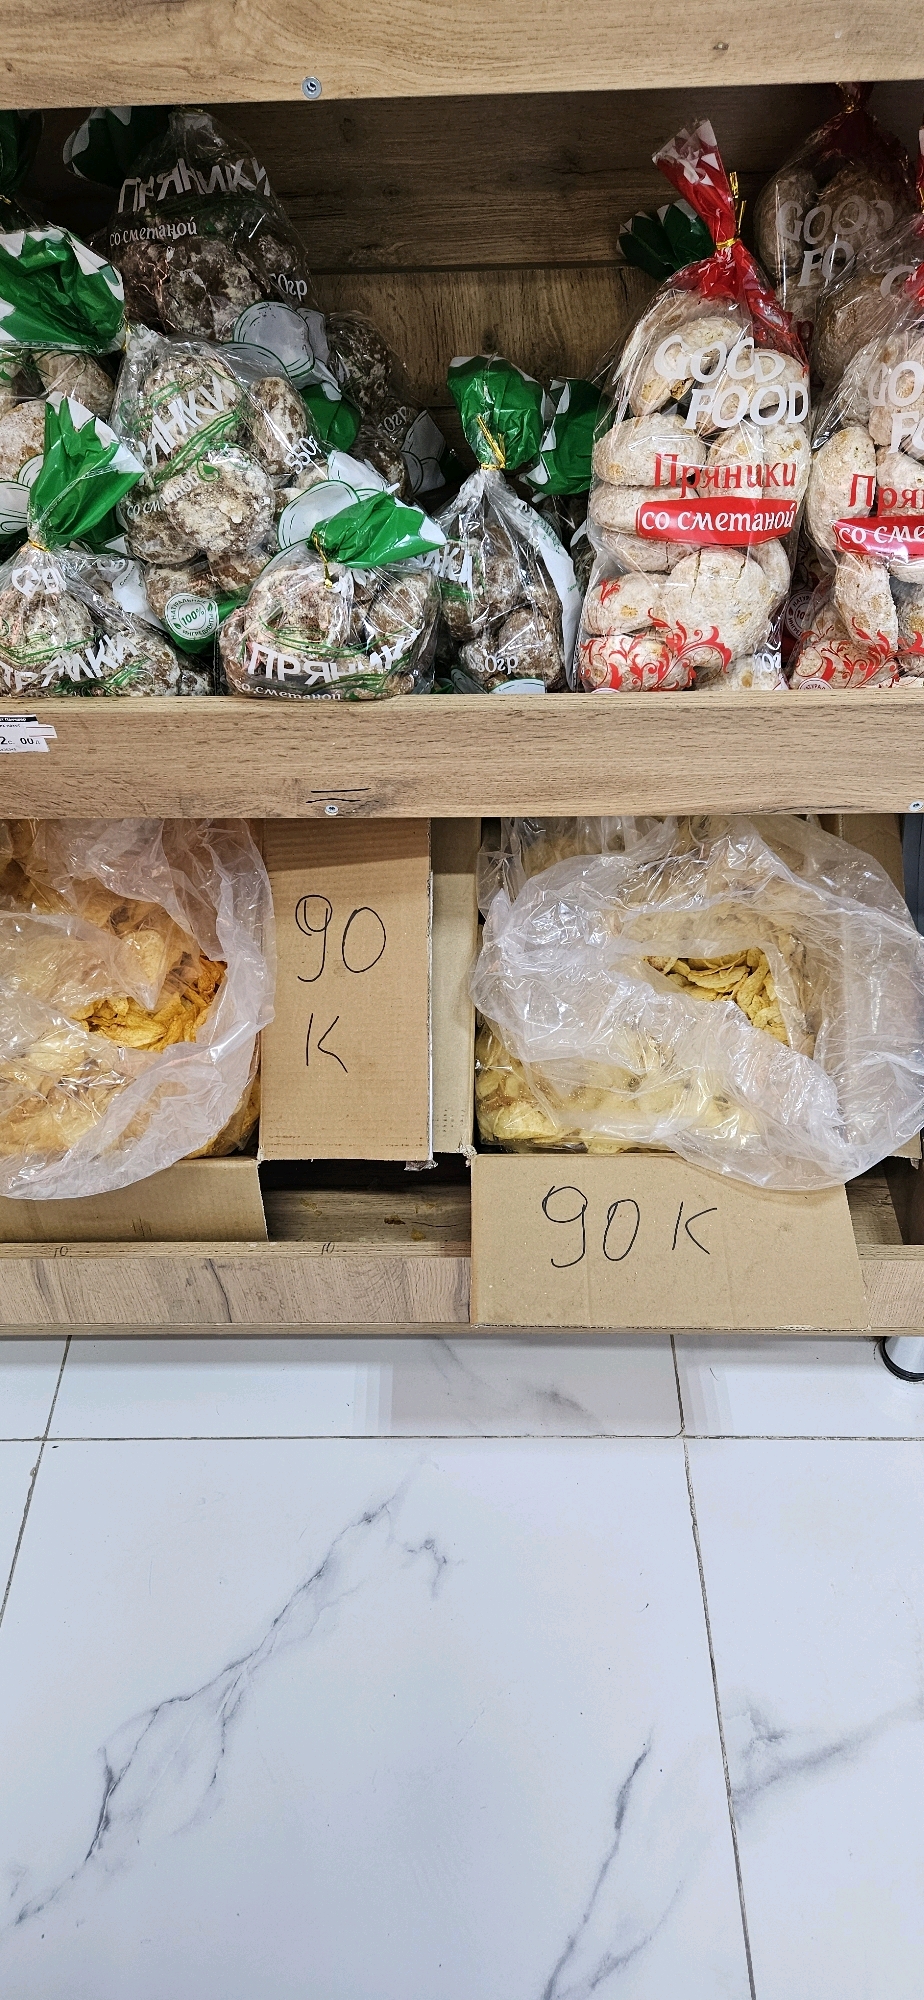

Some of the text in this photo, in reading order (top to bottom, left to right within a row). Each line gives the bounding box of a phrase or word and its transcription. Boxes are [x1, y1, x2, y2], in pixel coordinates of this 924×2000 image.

[123, 216, 198, 246] сметаной
[653, 334, 786, 384] GOOD
[683, 382, 809, 430] FOOD
[654, 452, 798, 499] Пряники
[641, 502, 797, 533] со сметаной
[838, 527, 867, 544] со
[295, 894, 387, 983] 90
[541, 1185, 641, 1269] 90
